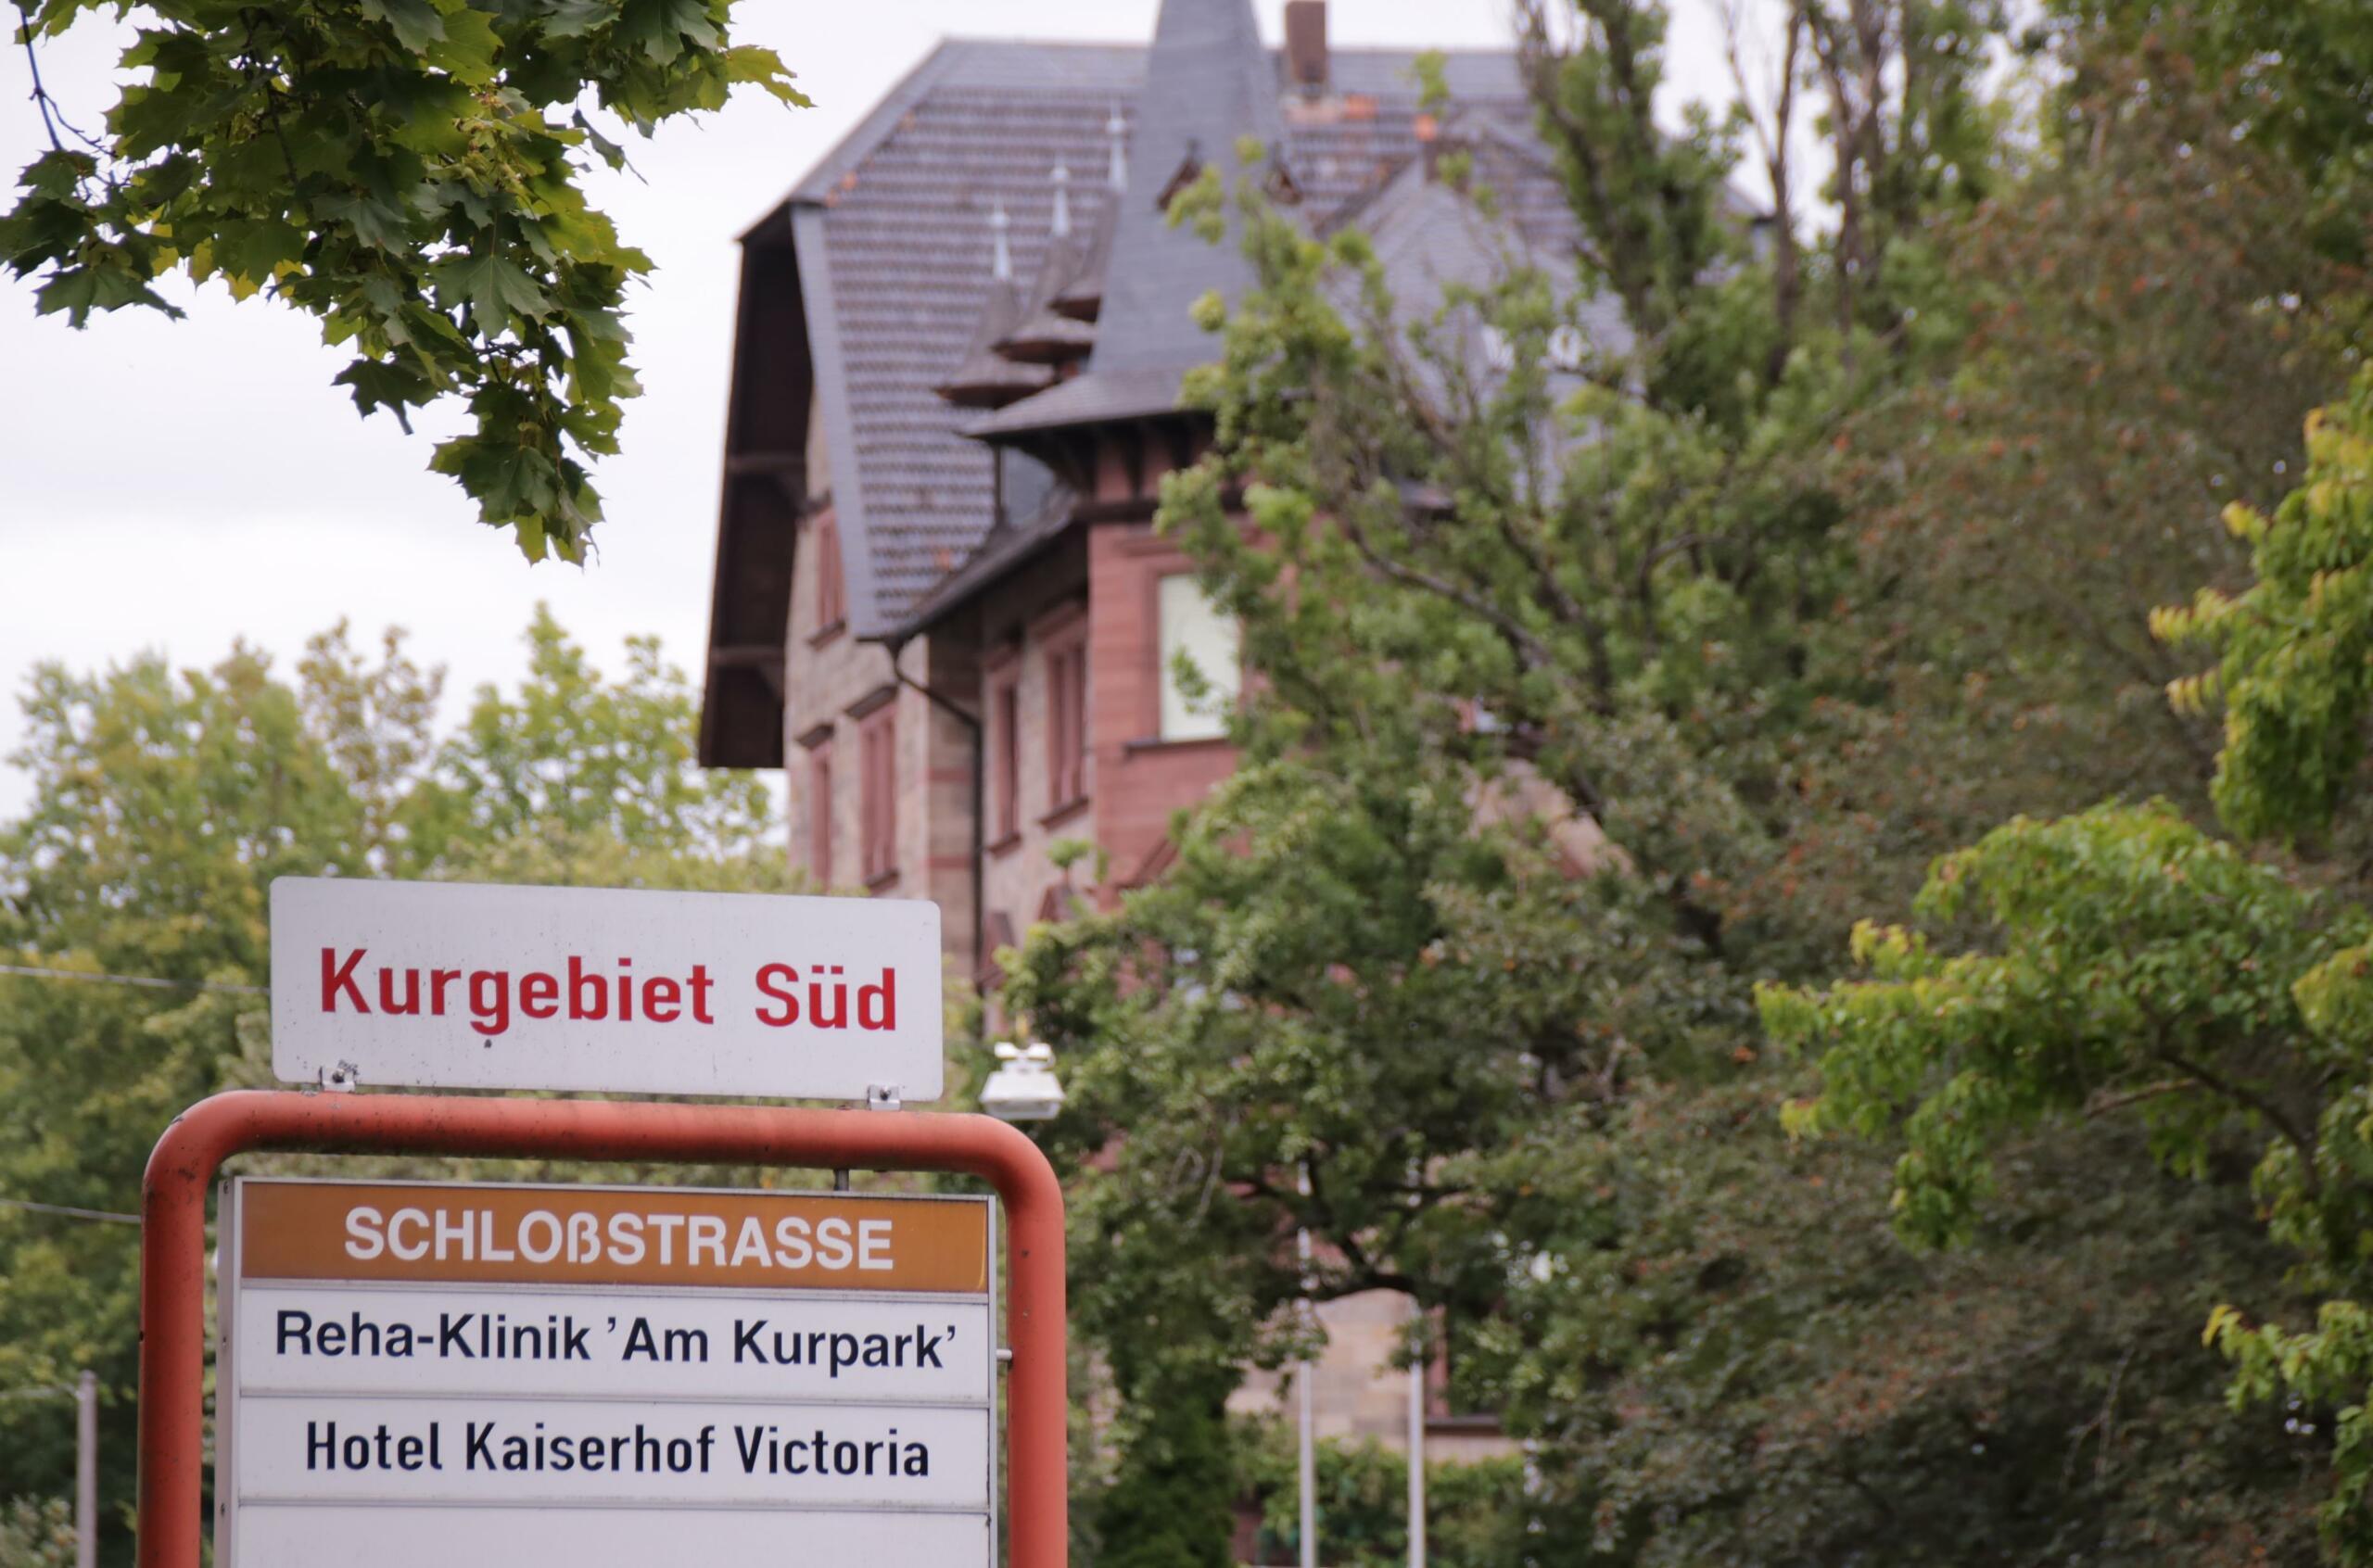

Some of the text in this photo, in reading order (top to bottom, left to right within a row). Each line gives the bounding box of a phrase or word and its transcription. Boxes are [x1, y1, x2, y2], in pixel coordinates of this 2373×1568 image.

[321, 947, 896, 1035] Kurgebiet Süd
[345, 1206, 895, 1271] SCHLOßSTRASSE
[276, 1309, 591, 1360] Reha-Klinik
[307, 1421, 929, 1477] Hotel Kaiserhof Victoria
